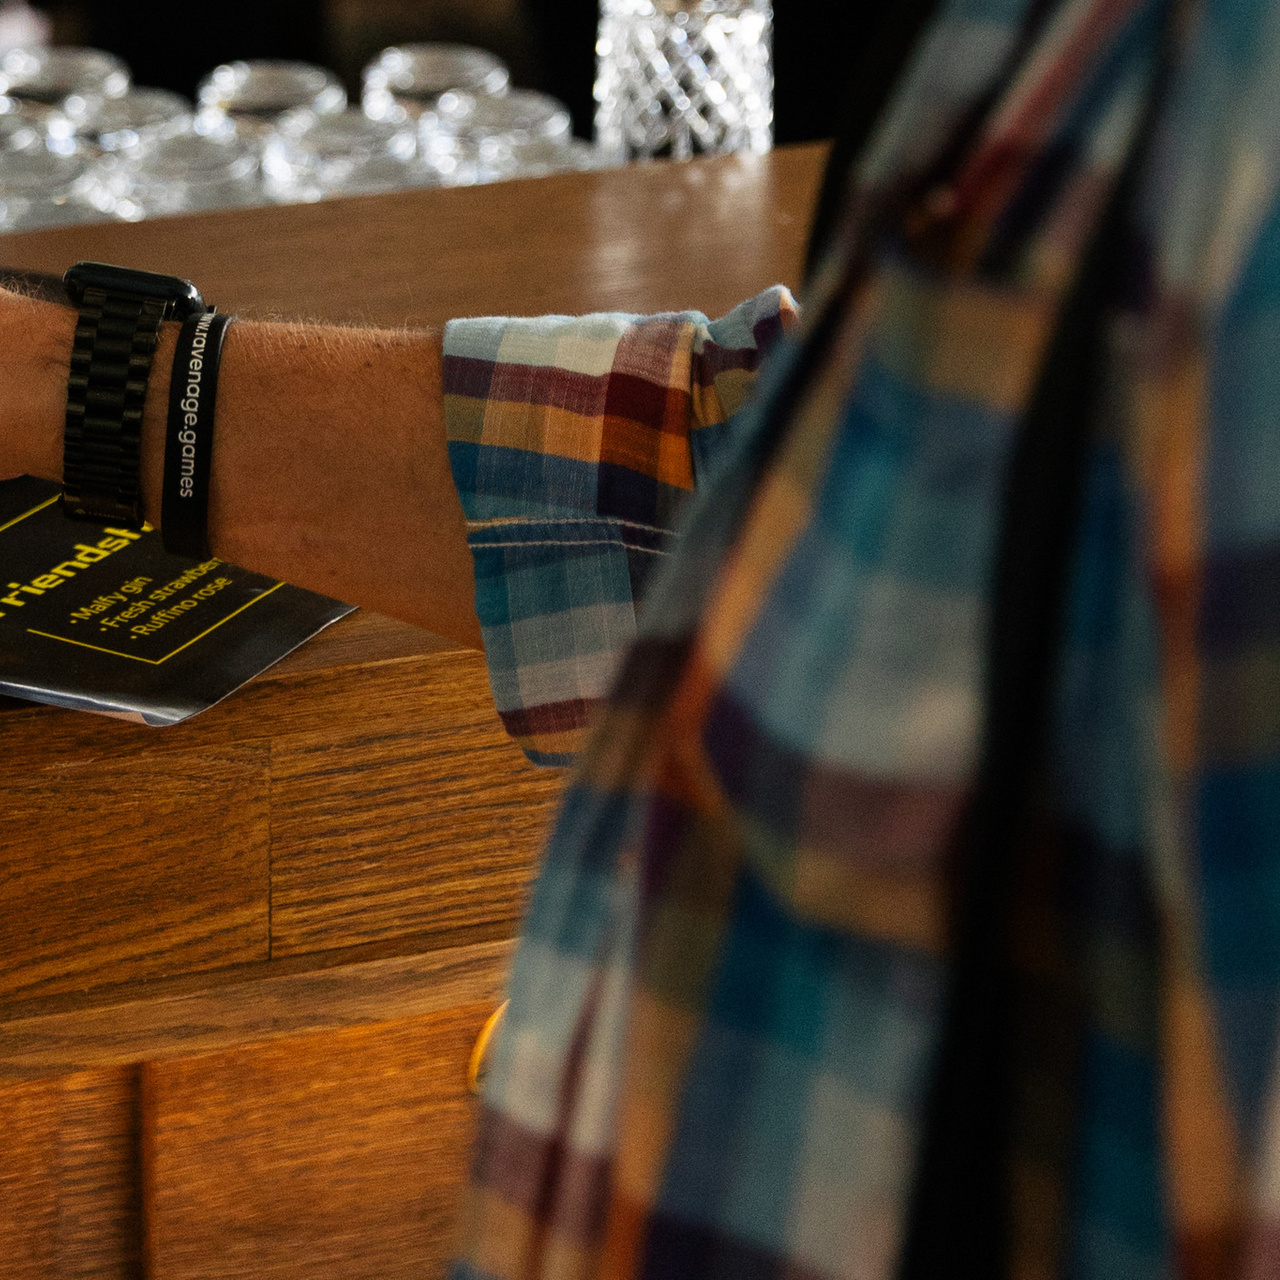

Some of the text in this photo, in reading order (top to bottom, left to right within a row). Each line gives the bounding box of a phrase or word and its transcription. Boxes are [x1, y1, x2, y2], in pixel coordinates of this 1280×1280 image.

[74, 574, 154, 622] Malfy gin
[103, 600, 157, 630] Fresh
[130, 577, 234, 636] Ruffino rose
